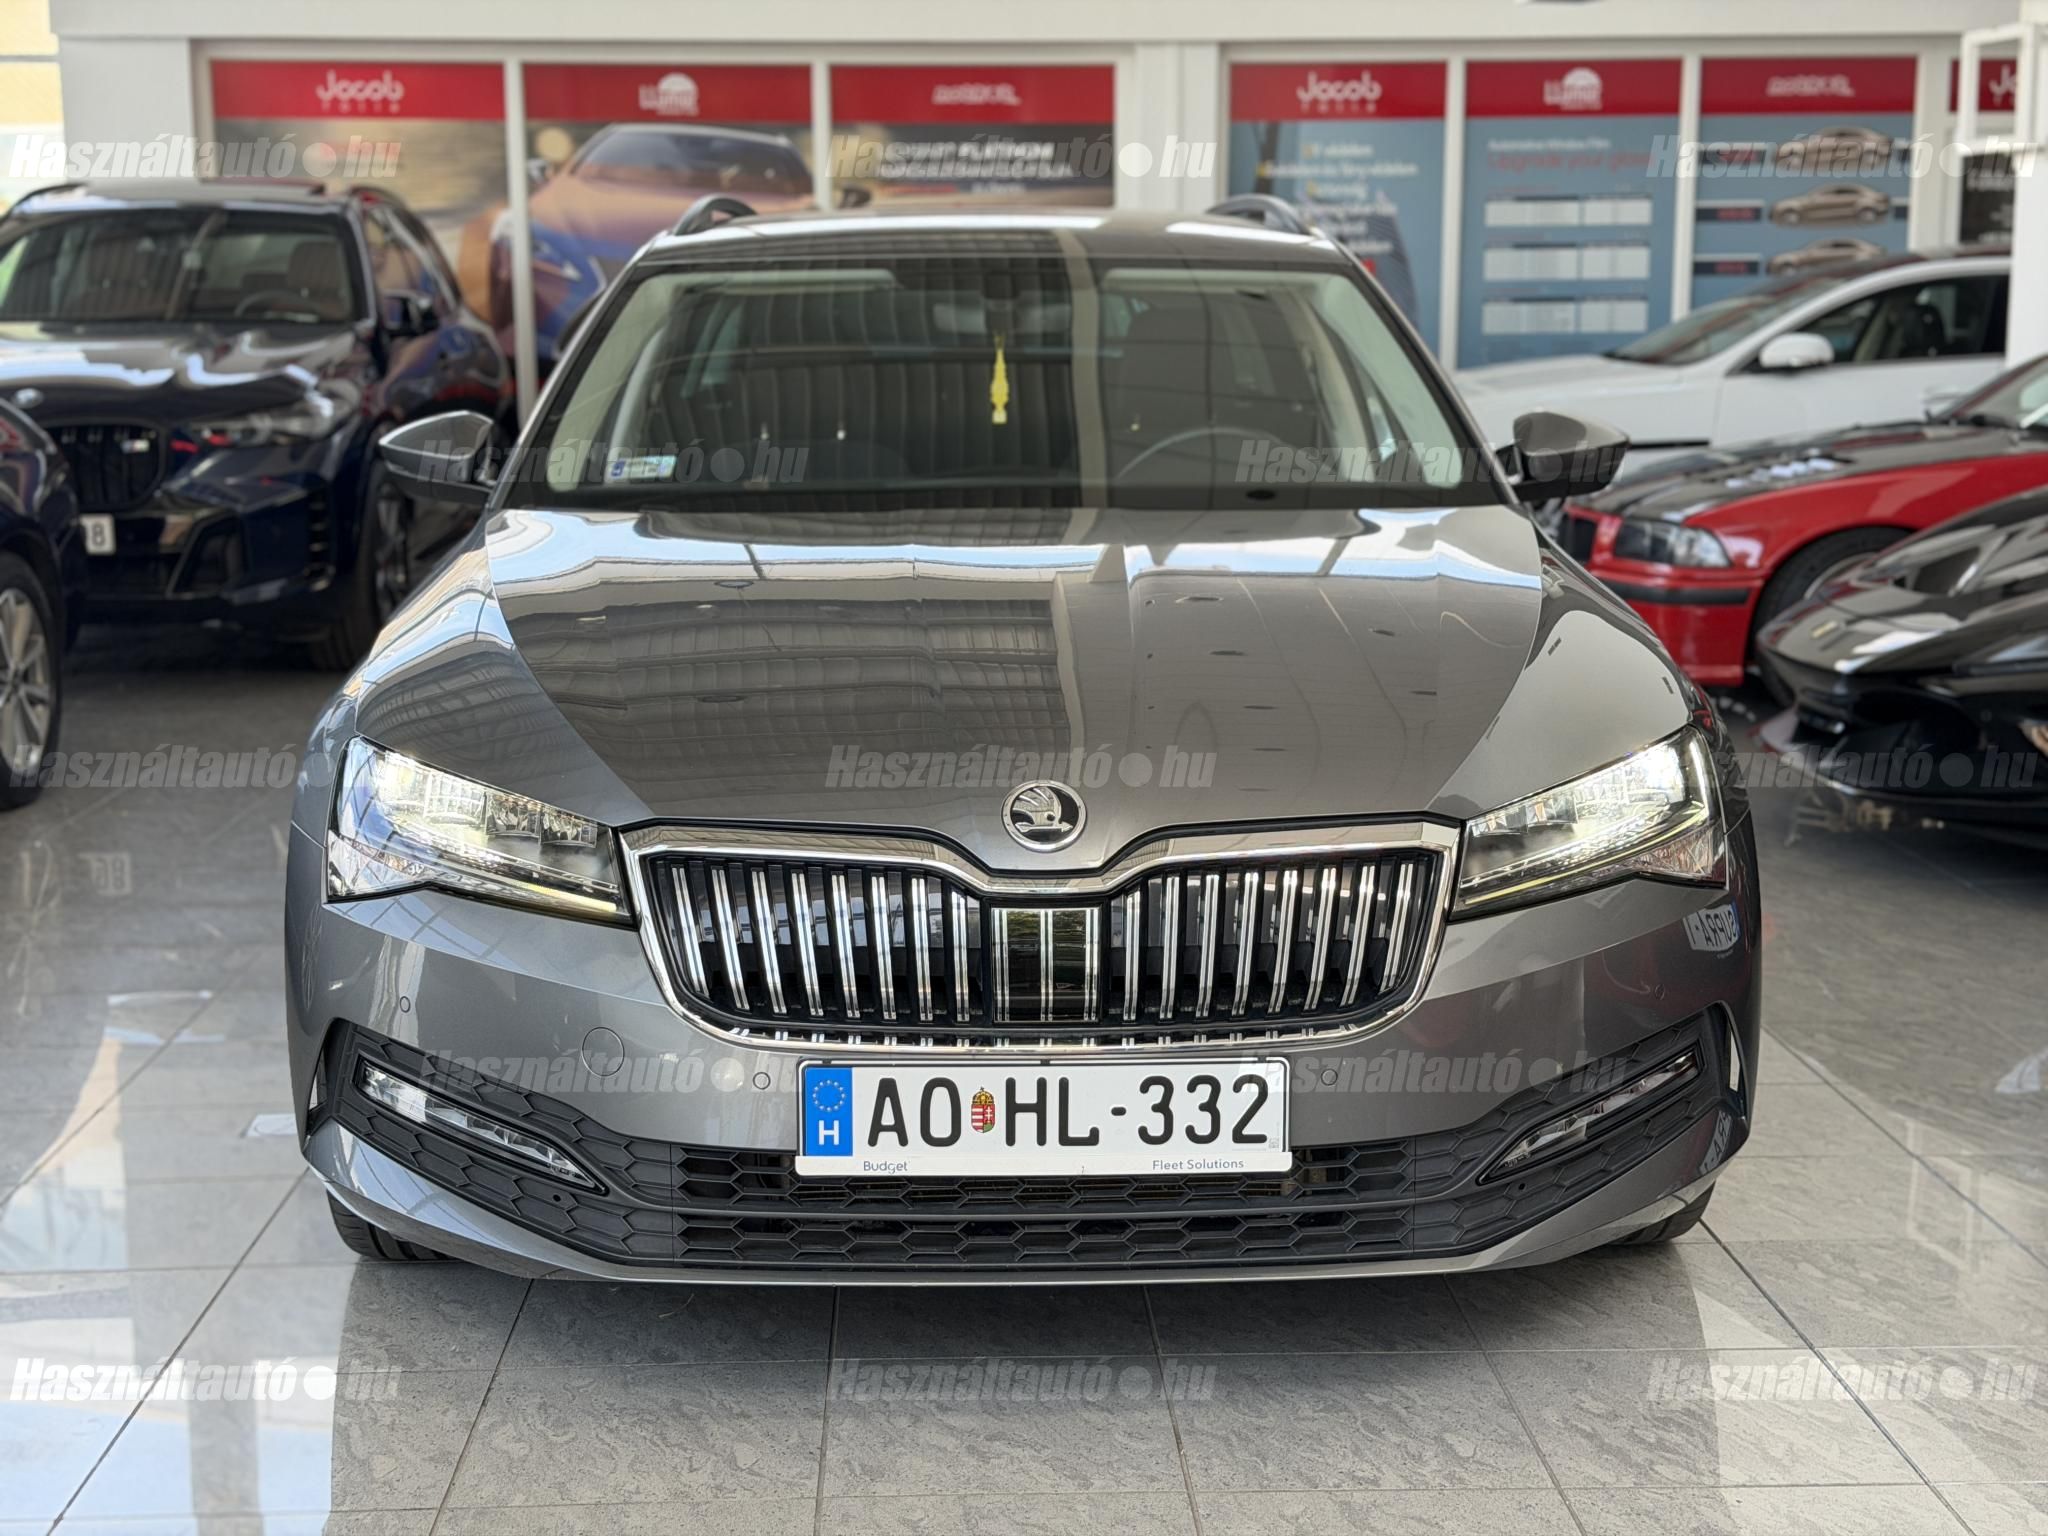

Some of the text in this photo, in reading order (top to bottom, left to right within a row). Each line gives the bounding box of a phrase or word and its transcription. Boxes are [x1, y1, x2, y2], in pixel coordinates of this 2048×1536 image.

[819, 1121, 839, 1144] H
[863, 1160, 908, 1174] Budget
[1152, 1159, 1244, 1170] Fleet Solutions
